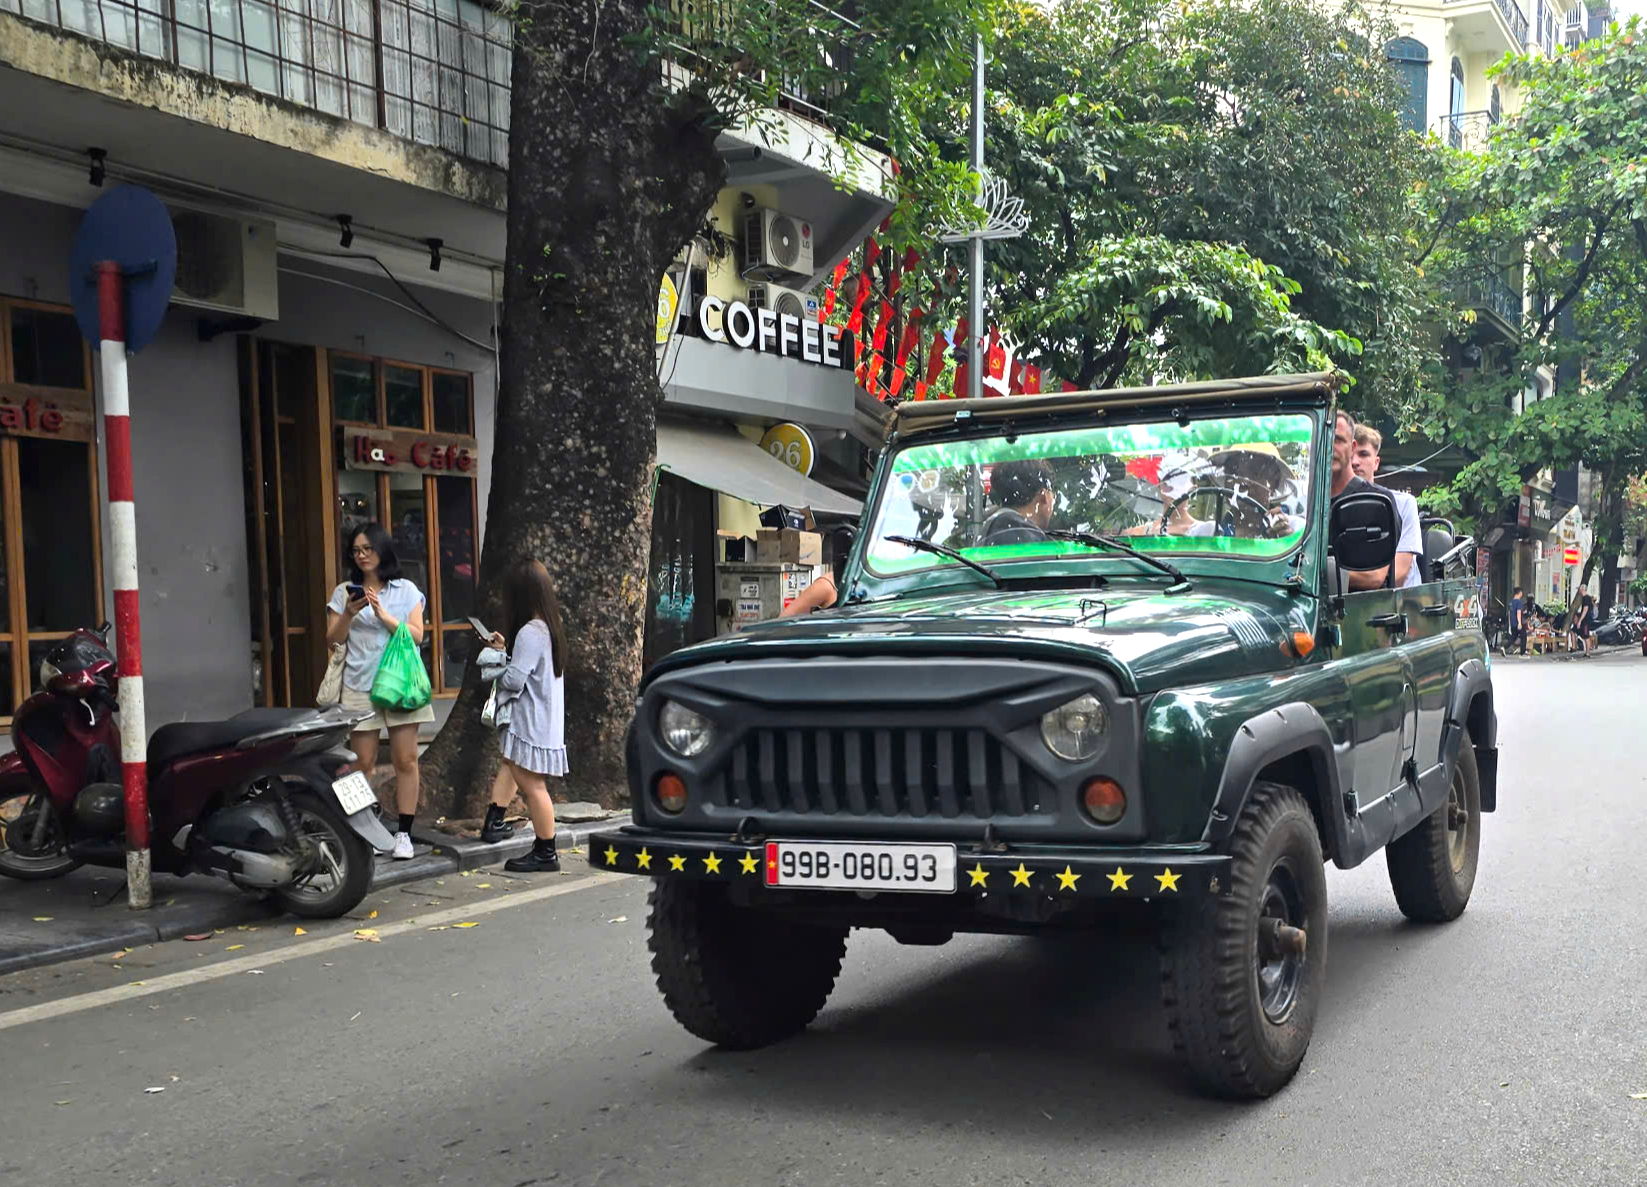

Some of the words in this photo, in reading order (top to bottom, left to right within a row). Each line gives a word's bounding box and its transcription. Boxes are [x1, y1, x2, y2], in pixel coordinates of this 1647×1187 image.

[699, 295, 841, 367] COFFEE
[770, 440, 801, 467] 26
[782, 850, 937, 883] 99B-080.93
